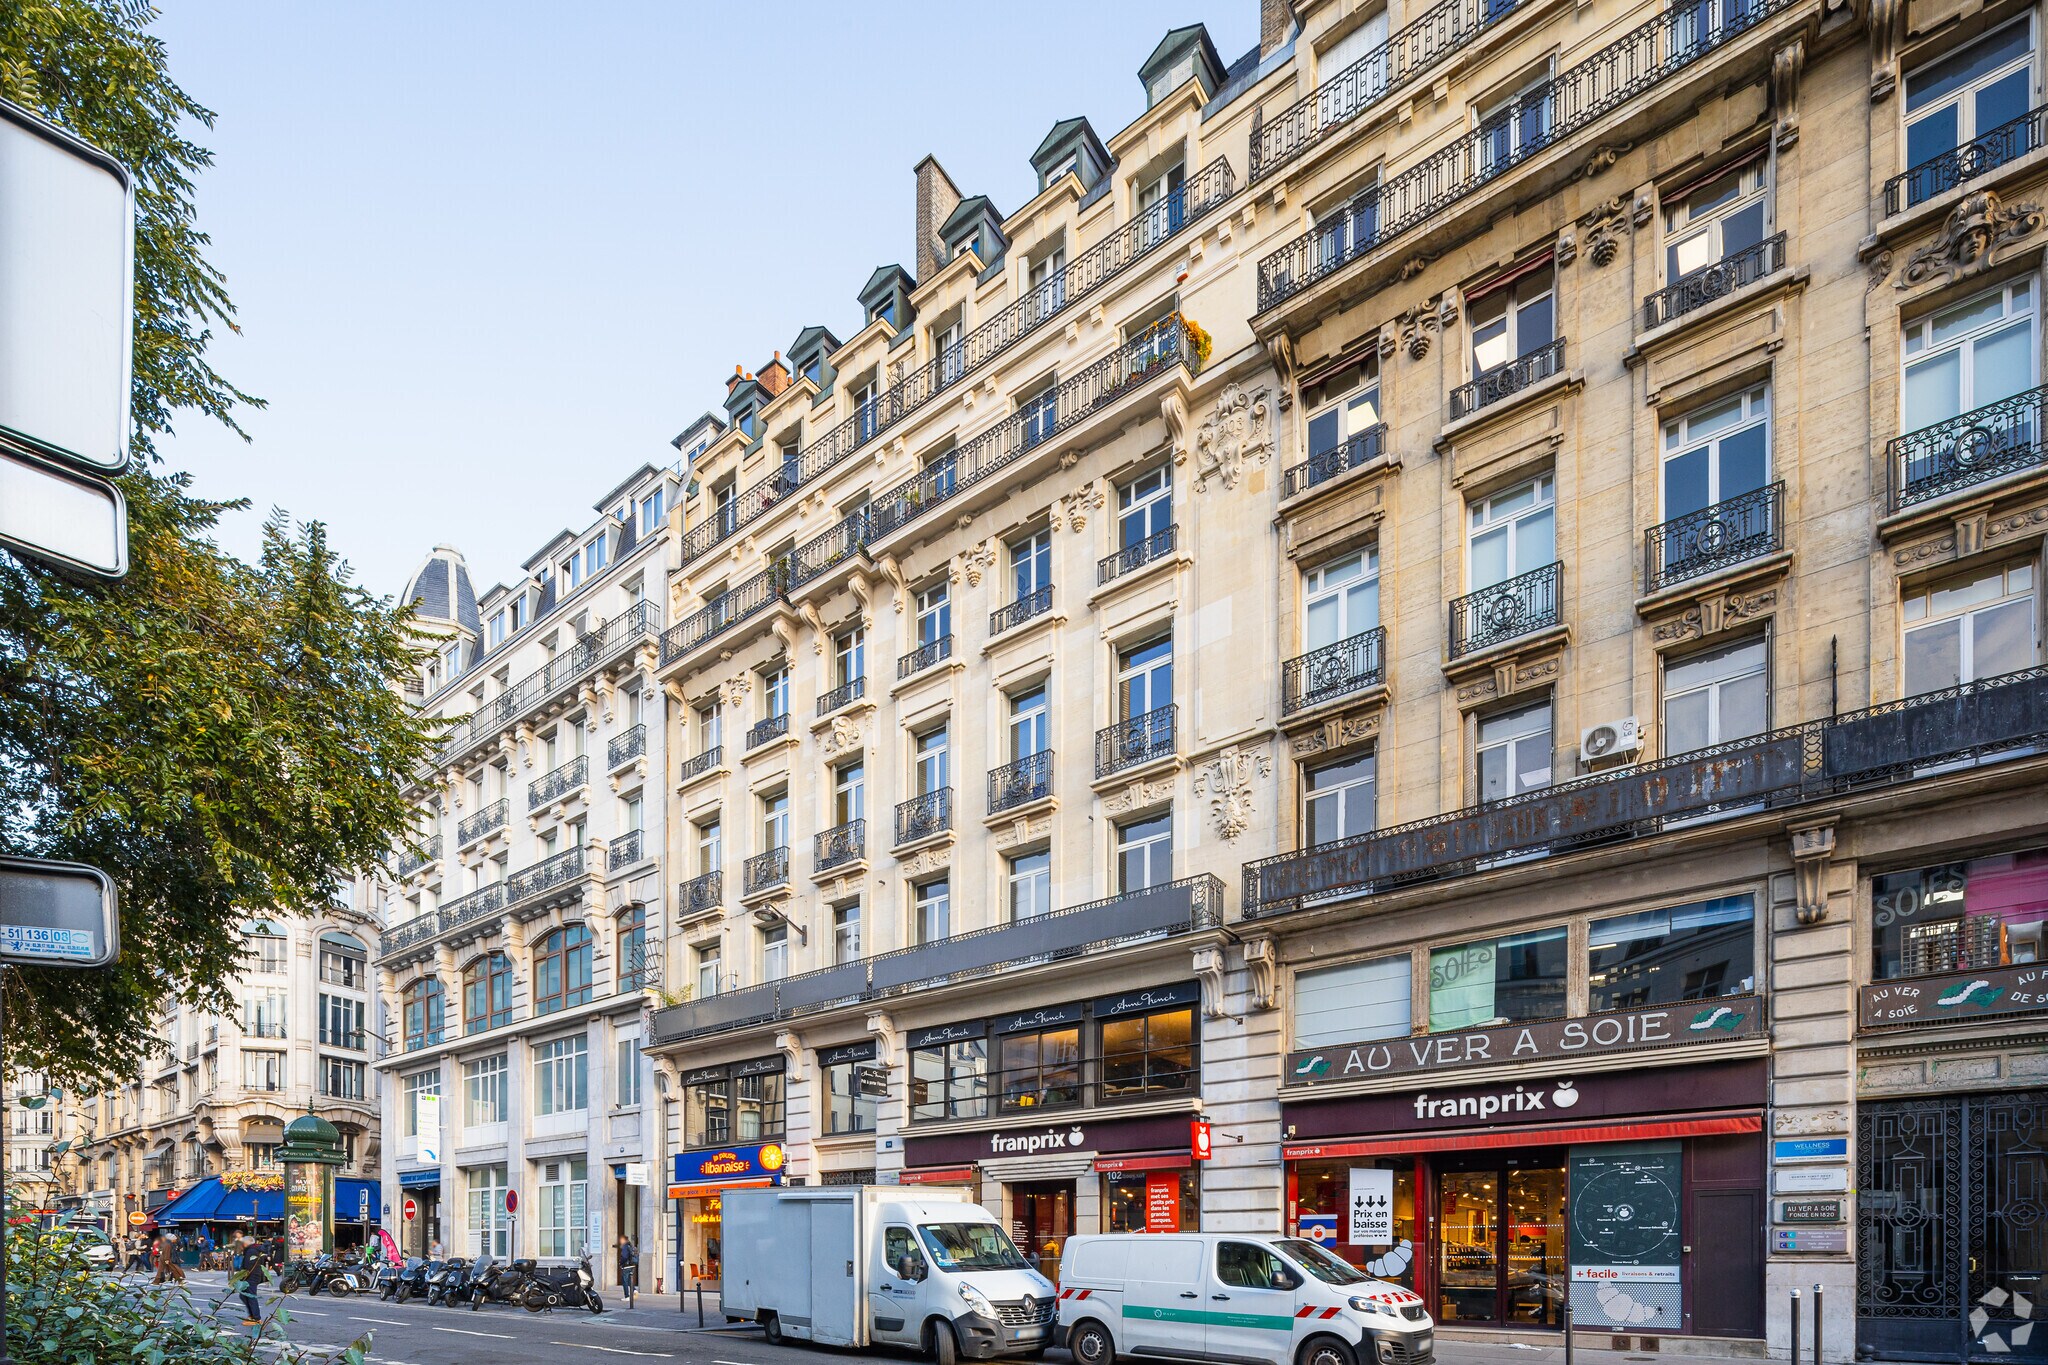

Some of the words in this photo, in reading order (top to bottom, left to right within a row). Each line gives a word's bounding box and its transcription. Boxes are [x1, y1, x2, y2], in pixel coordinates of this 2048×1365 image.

[1875, 863, 1969, 926] SOIES
[8, 928, 20, 938] 51
[26, 929, 49, 940] 136
[53, 931, 69, 942] 08
[1431, 947, 1493, 988] SOIES
[2018, 971, 2036, 986] AU
[1872, 989, 1889, 1003] AU
[1894, 986, 1921, 998] VER
[2010, 991, 2032, 1003] DE
[2036, 994, 2048, 1003] S
[1874, 1009, 1882, 1018] A
[1343, 1047, 1392, 1074] AU
[1410, 1034, 1492, 1067] VER
[1512, 1029, 1539, 1055] A
[1559, 1012, 1671, 1050] SOIE
[1413, 1085, 1546, 1119] franprix
[991, 1129, 1066, 1154] franprix
[719, 1152, 737, 1161] pause
[1286, 1148, 1314, 1156] franprix
[704, 1161, 745, 1174] libanaise
[1097, 1161, 1118, 1169] franprix
[1107, 1171, 1122, 1180] 102
[1354, 1210, 1373, 1218] Prix
[1354, 1219, 1388, 1228] baisse
[1586, 1269, 1618, 1279] facile
